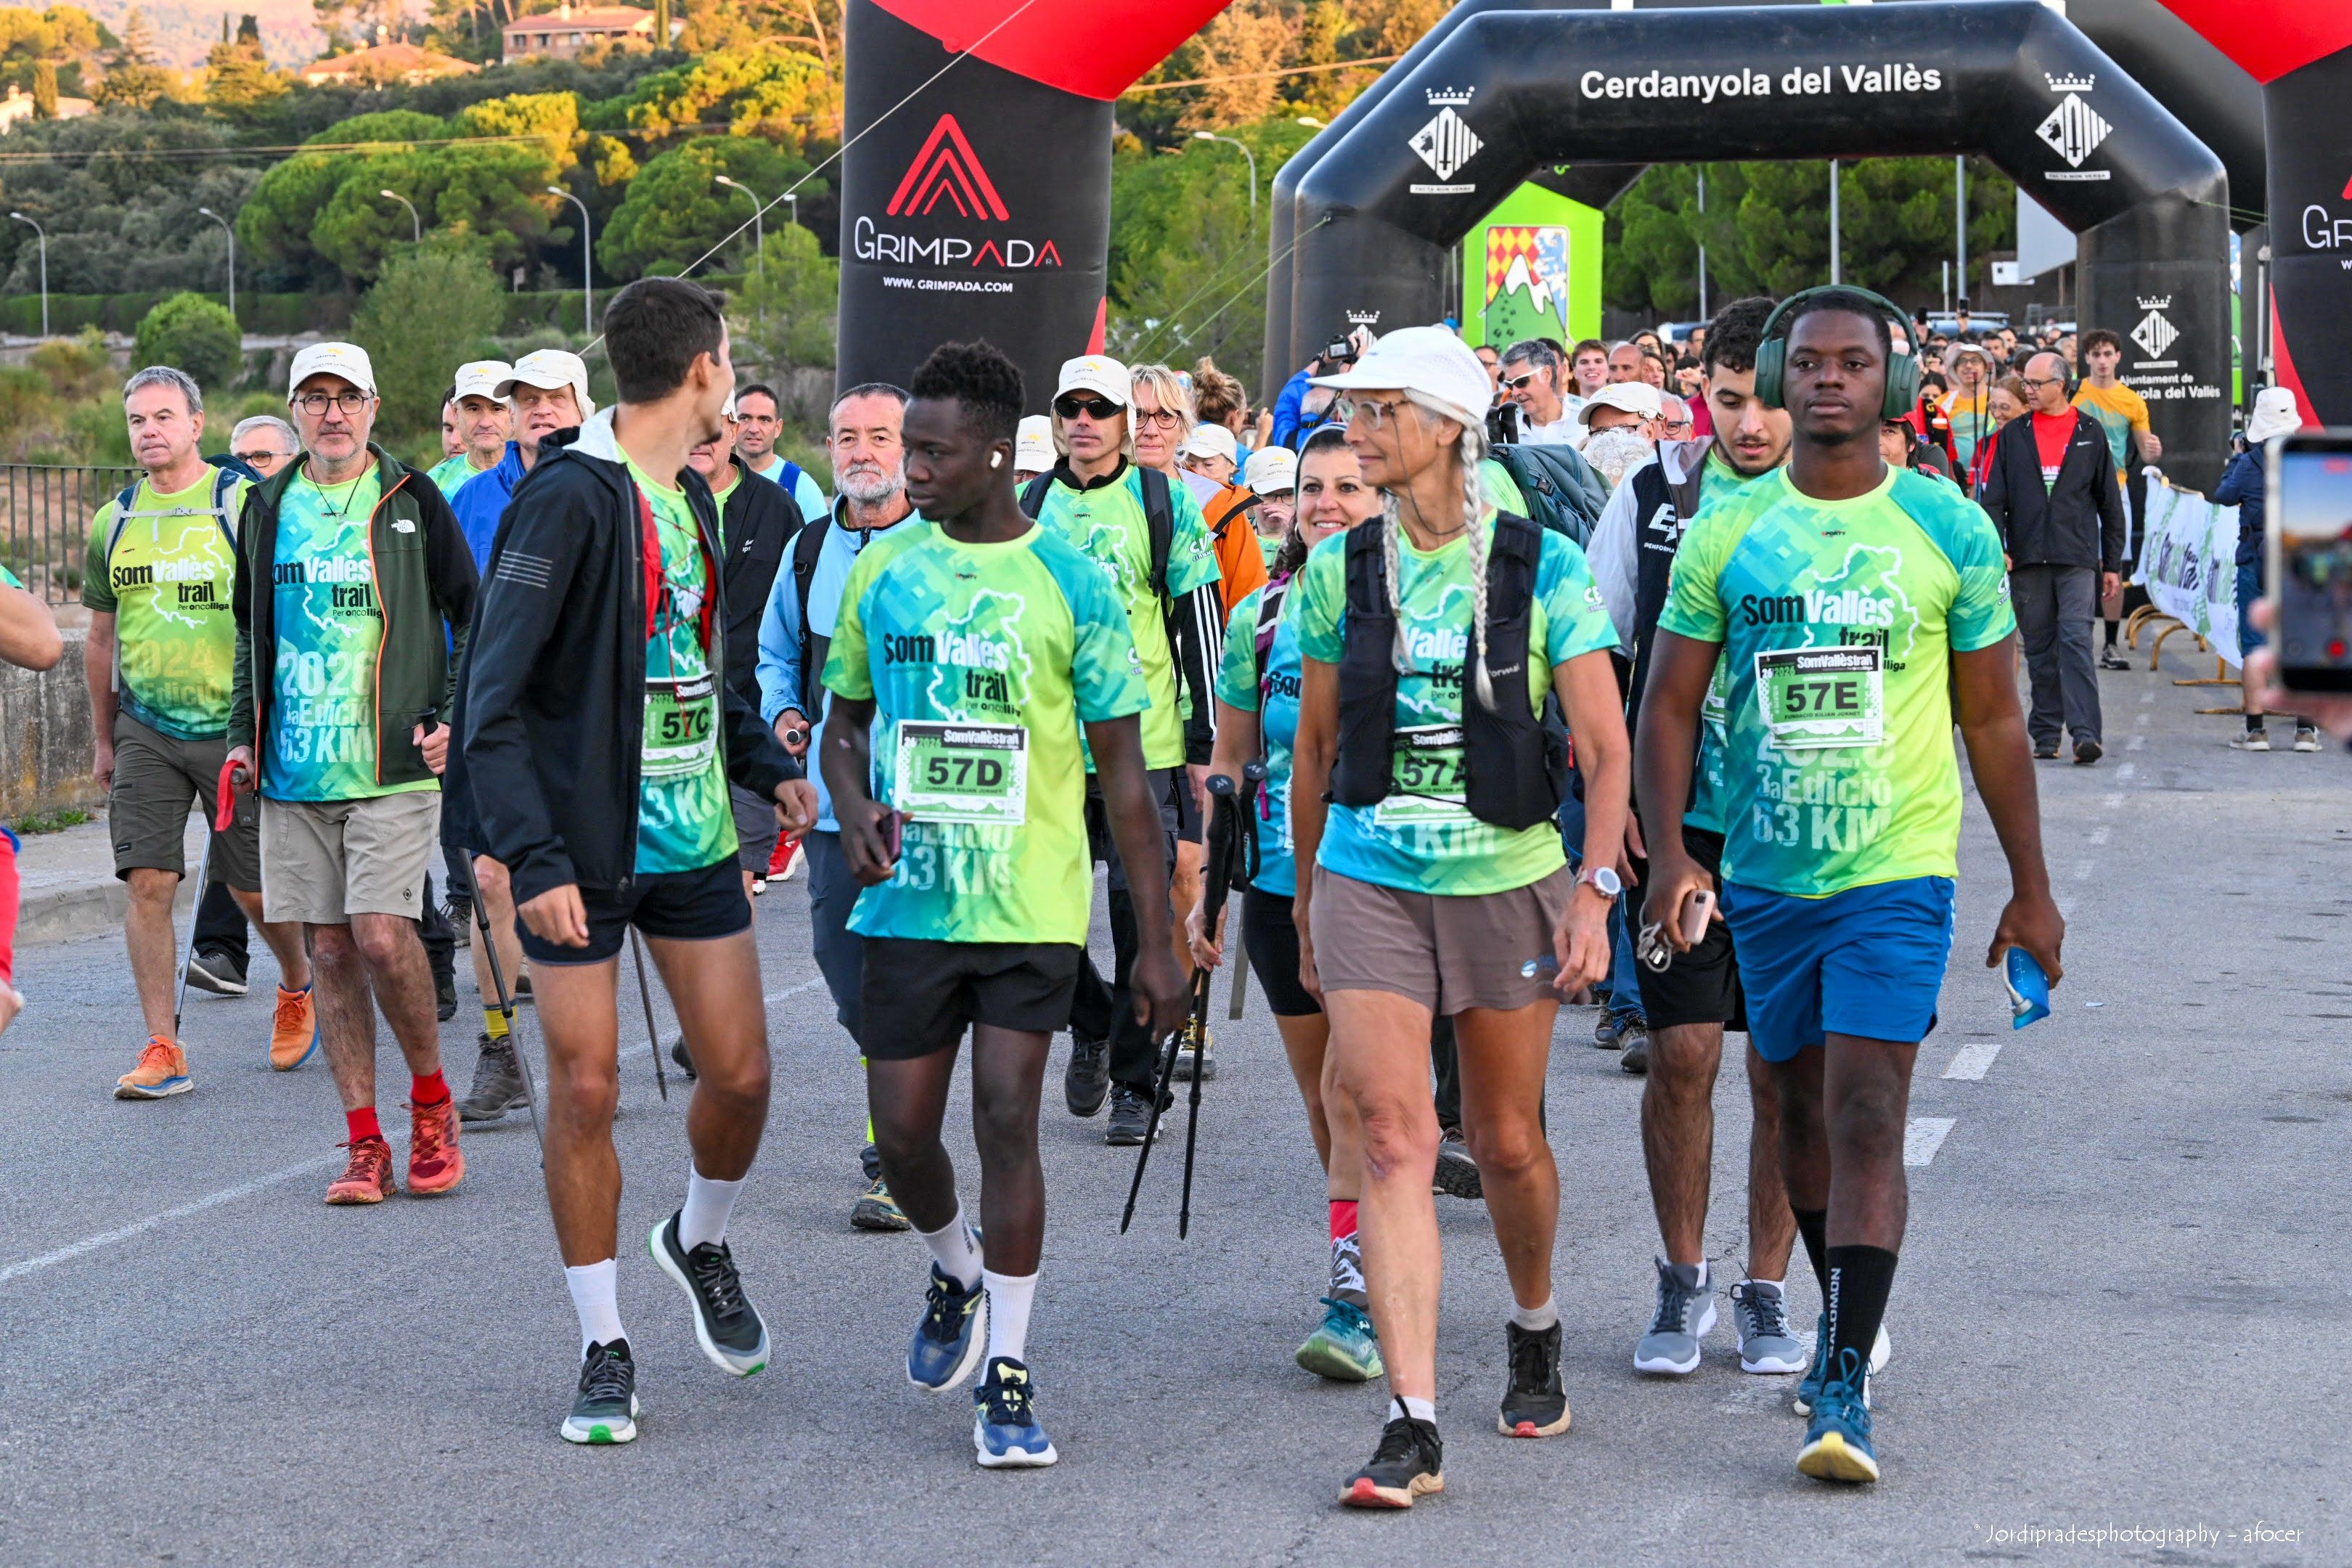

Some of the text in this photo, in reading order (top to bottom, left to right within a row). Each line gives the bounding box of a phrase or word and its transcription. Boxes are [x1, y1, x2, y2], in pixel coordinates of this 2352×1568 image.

[1580, 63, 1943, 103] Cerdanyola del Vallès
[854, 216, 1063, 268] GRIMPADA
[918, 279, 1013, 293] GRIMPADA.COM
[2120, 373, 2194, 386] Ajuntament de
[2165, 385, 2186, 399] del
[2189, 385, 2221, 399] Vallès
[177, 581, 215, 603] trail
[331, 583, 372, 608] trail
[189, 602, 229, 611] oncolliga
[346, 608, 383, 618] oncollig
[965, 669, 1008, 703] trail
[1786, 682, 1858, 712] 57E
[316, 727, 374, 763] KM
[927, 757, 1003, 787] 57D
[1753, 801, 1892, 852] 63 KM
